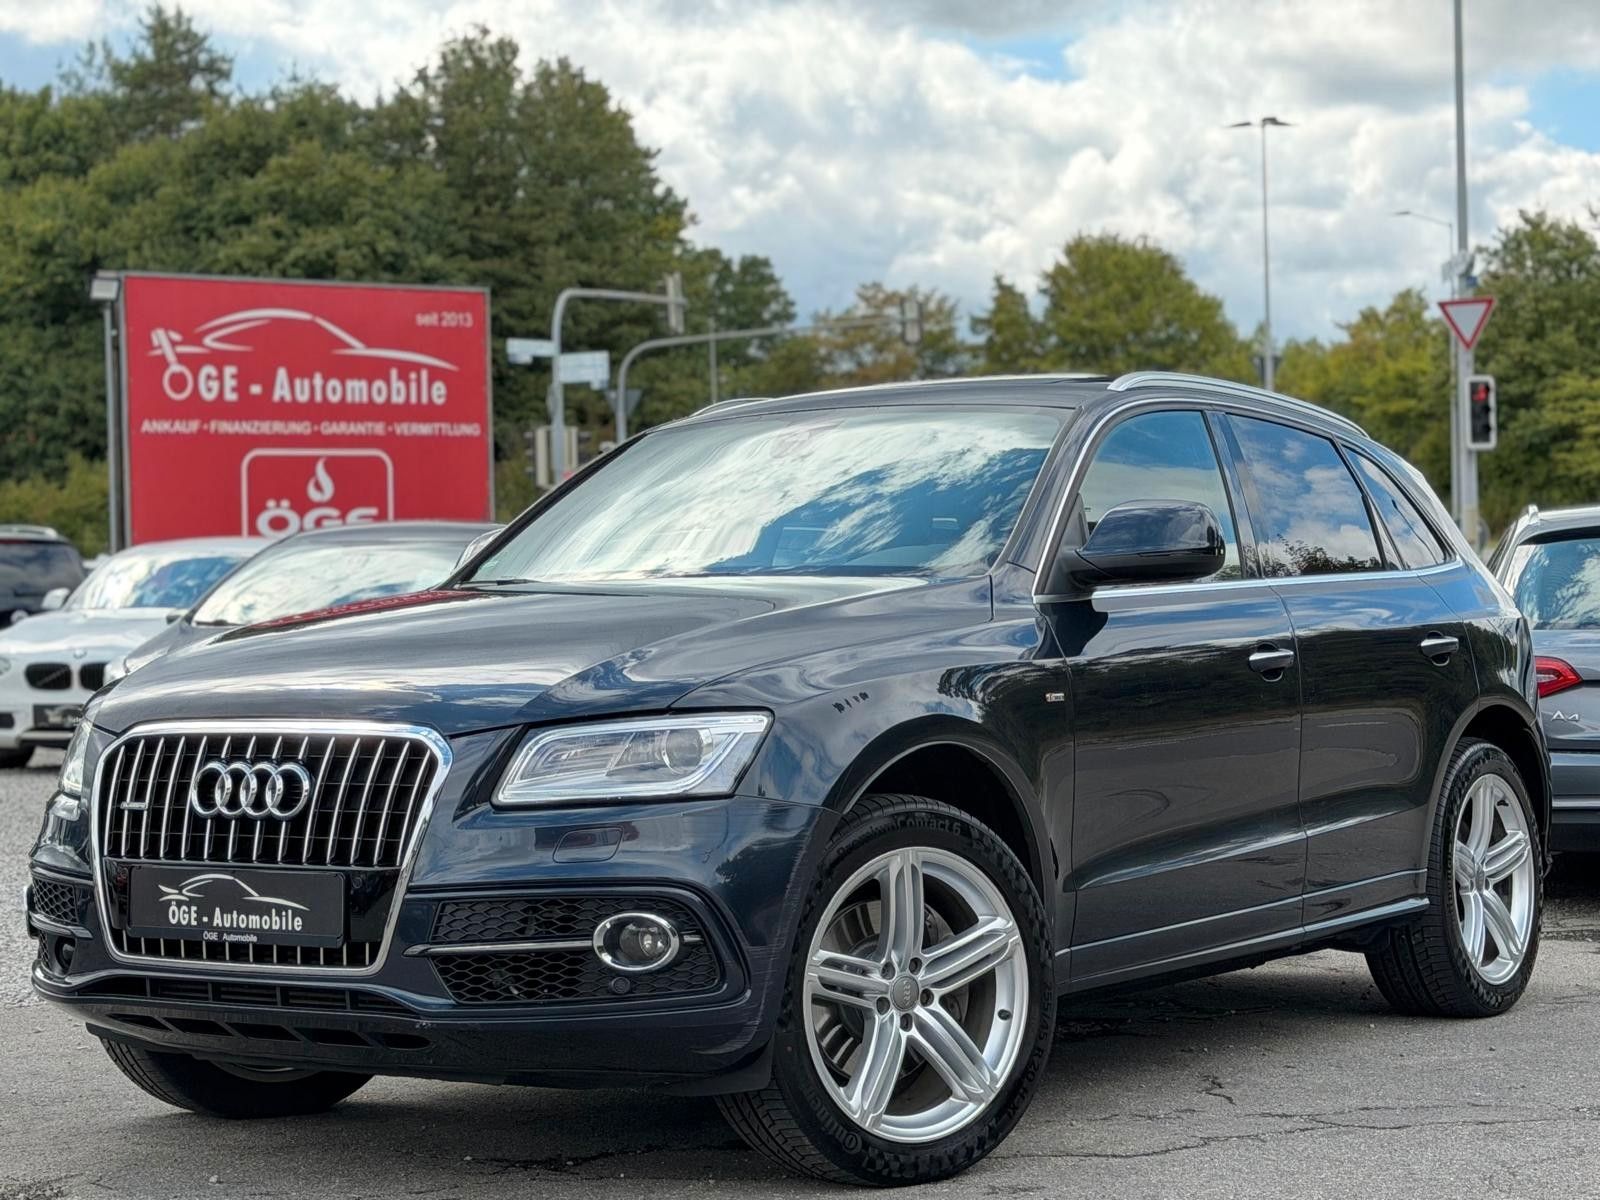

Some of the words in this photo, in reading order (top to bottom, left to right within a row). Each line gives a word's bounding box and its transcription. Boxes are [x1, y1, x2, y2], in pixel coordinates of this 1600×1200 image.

[415, 311, 439, 327] seit
[440, 311, 474, 328] 2013
[272, 367, 447, 406] Automobile
[140, 418, 201, 434] ANKAUF
[209, 419, 312, 436] FINANZIERUNG
[320, 421, 387, 436] GARANTIE
[394, 422, 481, 437] VERMITTLUNG
[1551, 710, 1579, 721] A4
[168, 900, 198, 925] ÖGE
[213, 907, 303, 931] Automobile
[203, 930, 219, 940] ÖGE
[222, 932, 258, 942] Automobile
